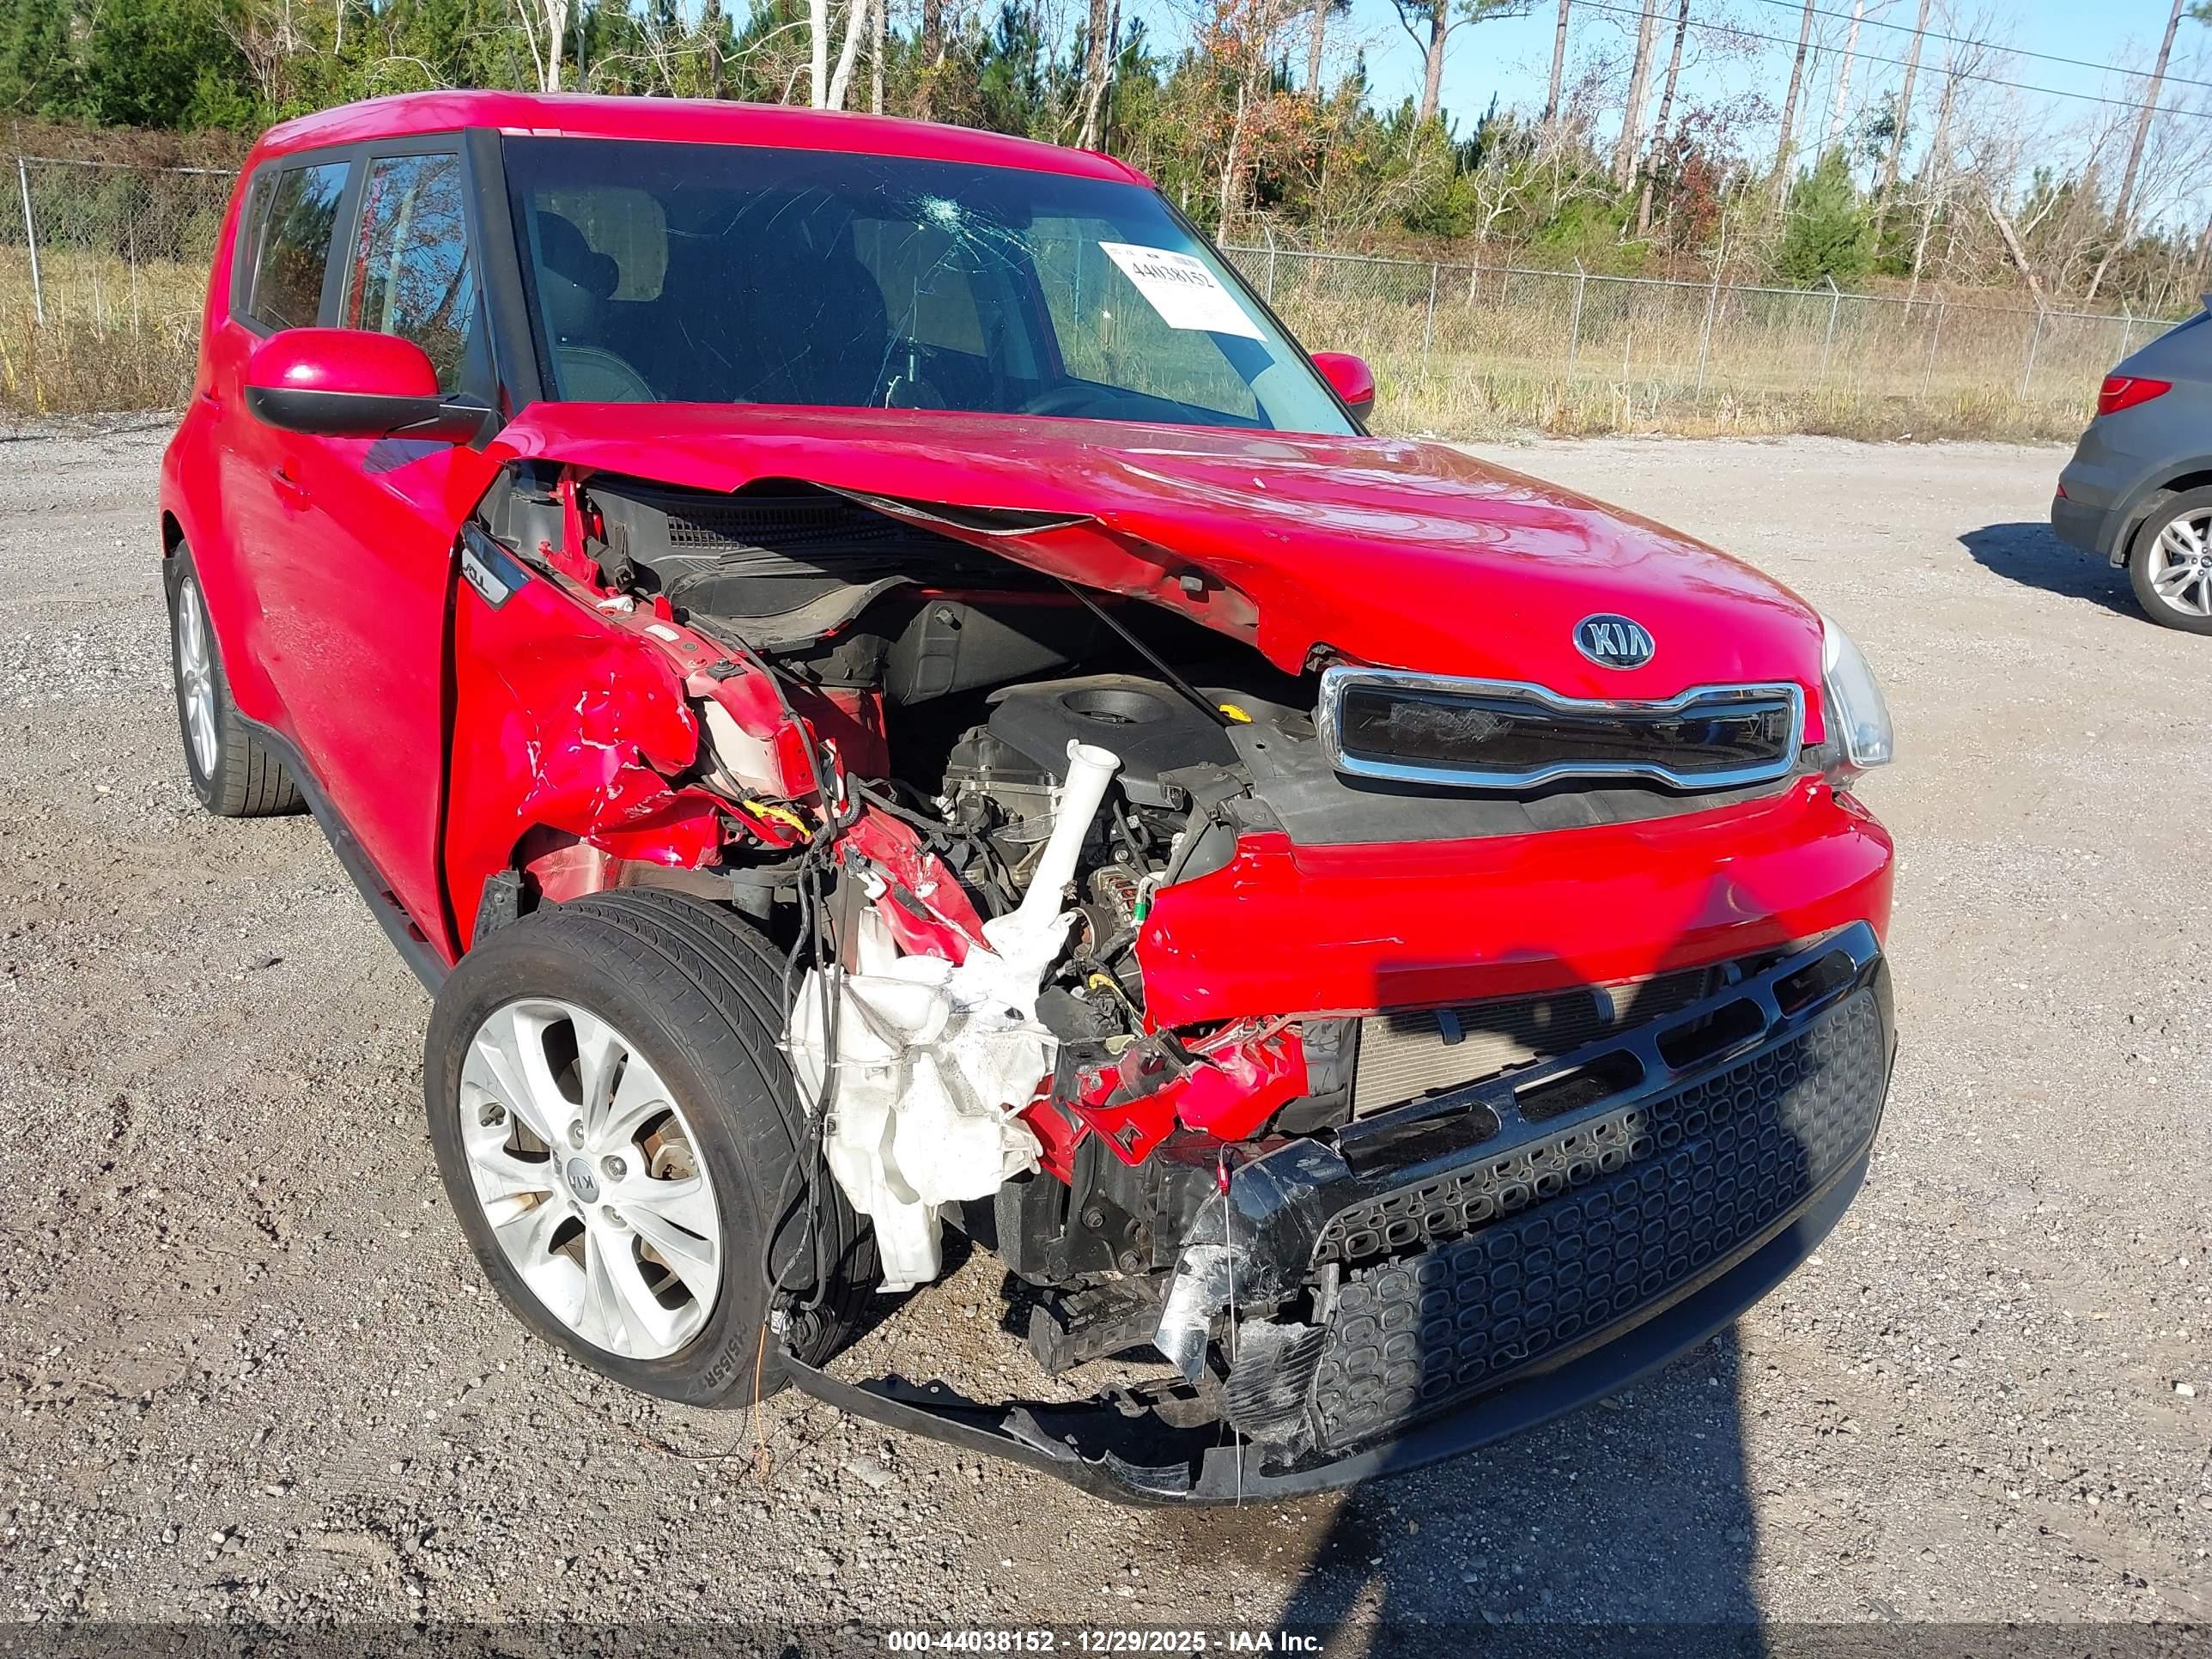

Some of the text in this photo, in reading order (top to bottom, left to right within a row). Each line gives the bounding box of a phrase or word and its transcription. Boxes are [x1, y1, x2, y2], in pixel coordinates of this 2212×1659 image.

[1133, 262, 1215, 289] 44038152
[1587, 623, 1650, 656] KIA
[568, 1175, 594, 1189] KIA
